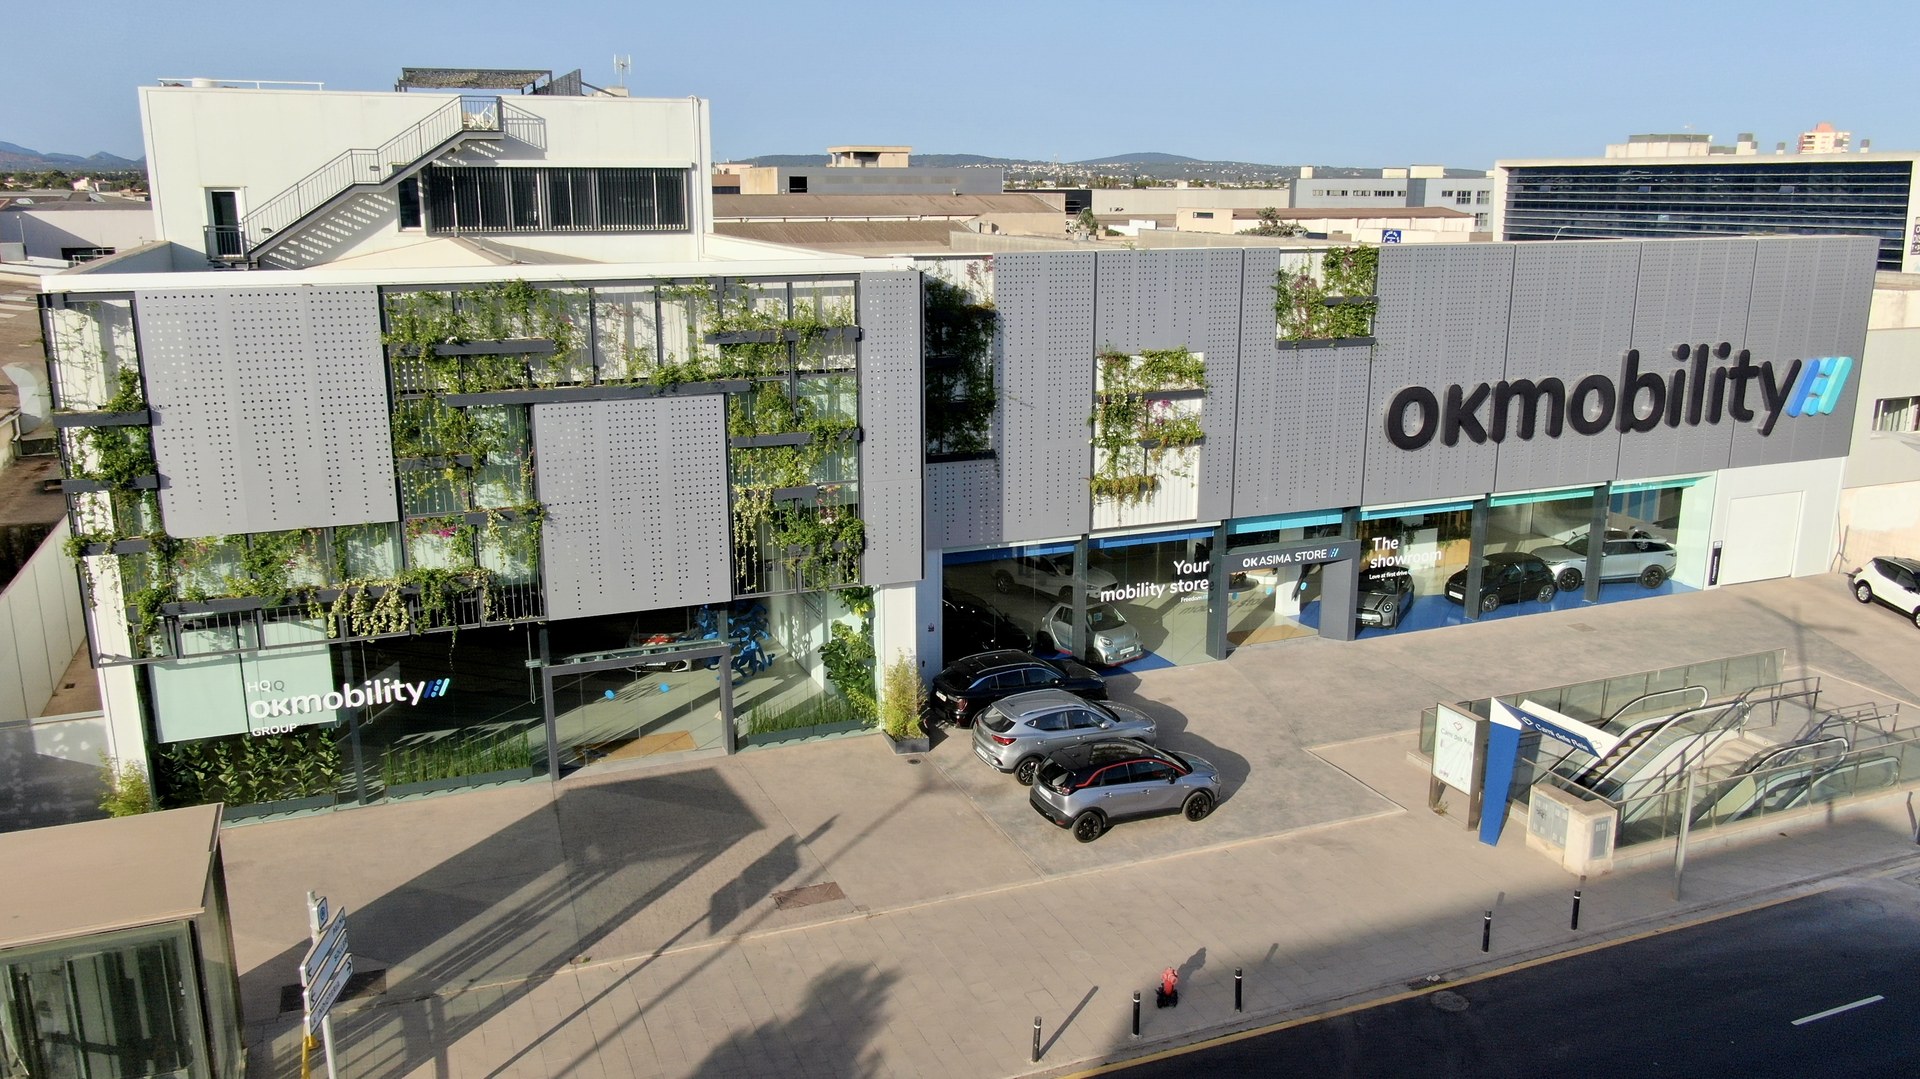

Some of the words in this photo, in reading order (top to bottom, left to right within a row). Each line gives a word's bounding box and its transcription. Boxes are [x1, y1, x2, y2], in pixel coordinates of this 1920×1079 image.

[1371, 536, 1399, 551] The
[1295, 548, 1328, 562] STORE
[1369, 550, 1442, 569] showroom
[1173, 559, 1210, 575] Your
[1100, 582, 1165, 603] mobility
[1169, 578, 1209, 593] store
[246, 680, 271, 692] HQ
[252, 723, 298, 737] GROUP
